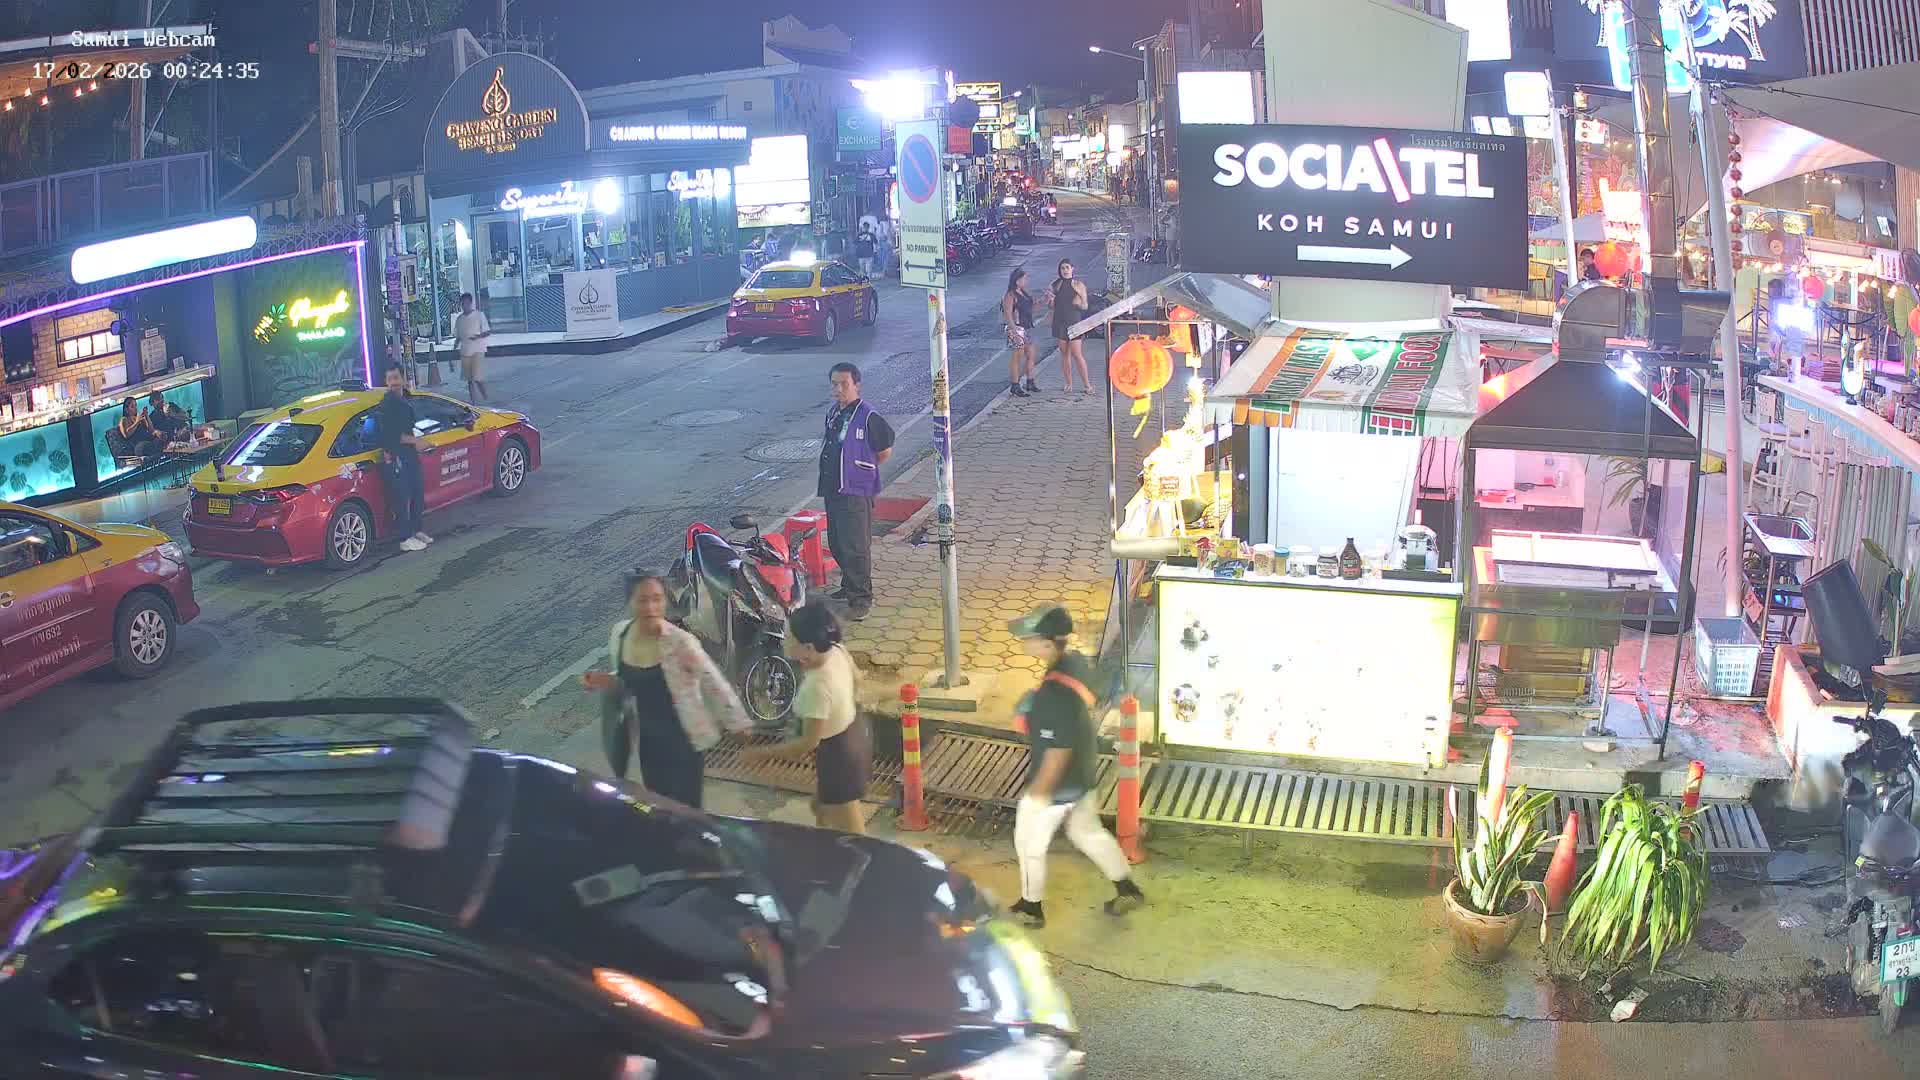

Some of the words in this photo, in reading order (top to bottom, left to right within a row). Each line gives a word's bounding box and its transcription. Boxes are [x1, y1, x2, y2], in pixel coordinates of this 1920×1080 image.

[839, 135, 881, 145] EXCHANGE
[1257, 213, 1323, 232] KOH
[1344, 216, 1453, 239] SAMUI
[906, 243, 914, 253] NO
[914, 244, 938, 254] PARKING
[1896, 966, 1910, 979] 23
